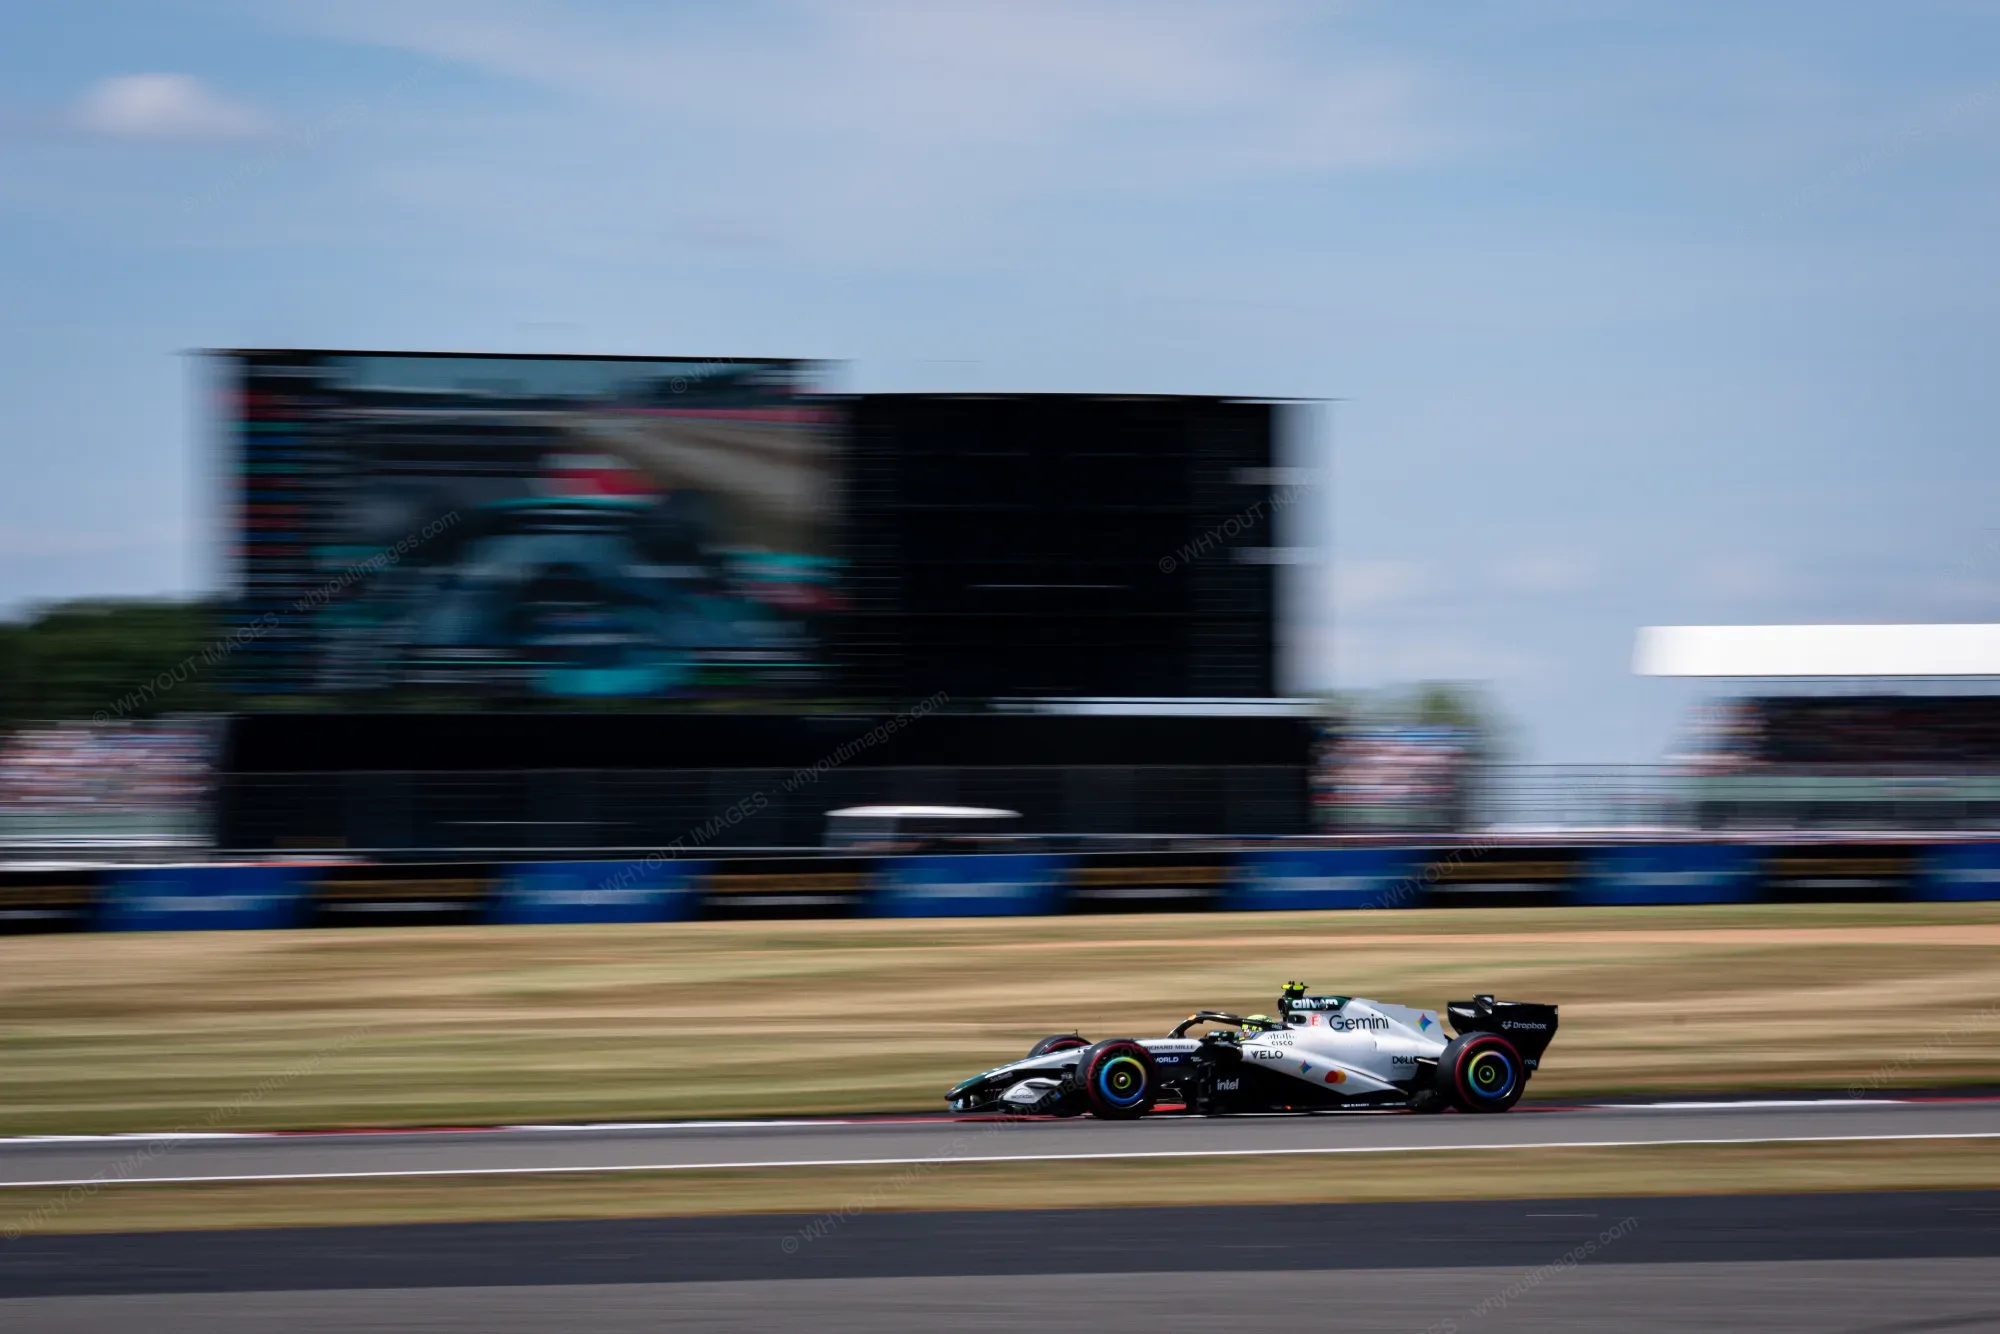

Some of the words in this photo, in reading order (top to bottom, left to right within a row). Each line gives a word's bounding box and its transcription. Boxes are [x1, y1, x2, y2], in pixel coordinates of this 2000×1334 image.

[1329, 1013, 1389, 1031] Gemini
[1512, 1021, 1547, 1030] Dropbox
[1251, 1050, 1284, 1060] VELO
[1392, 1056, 1415, 1065] DELL
[1217, 1078, 1239, 1090] intel
